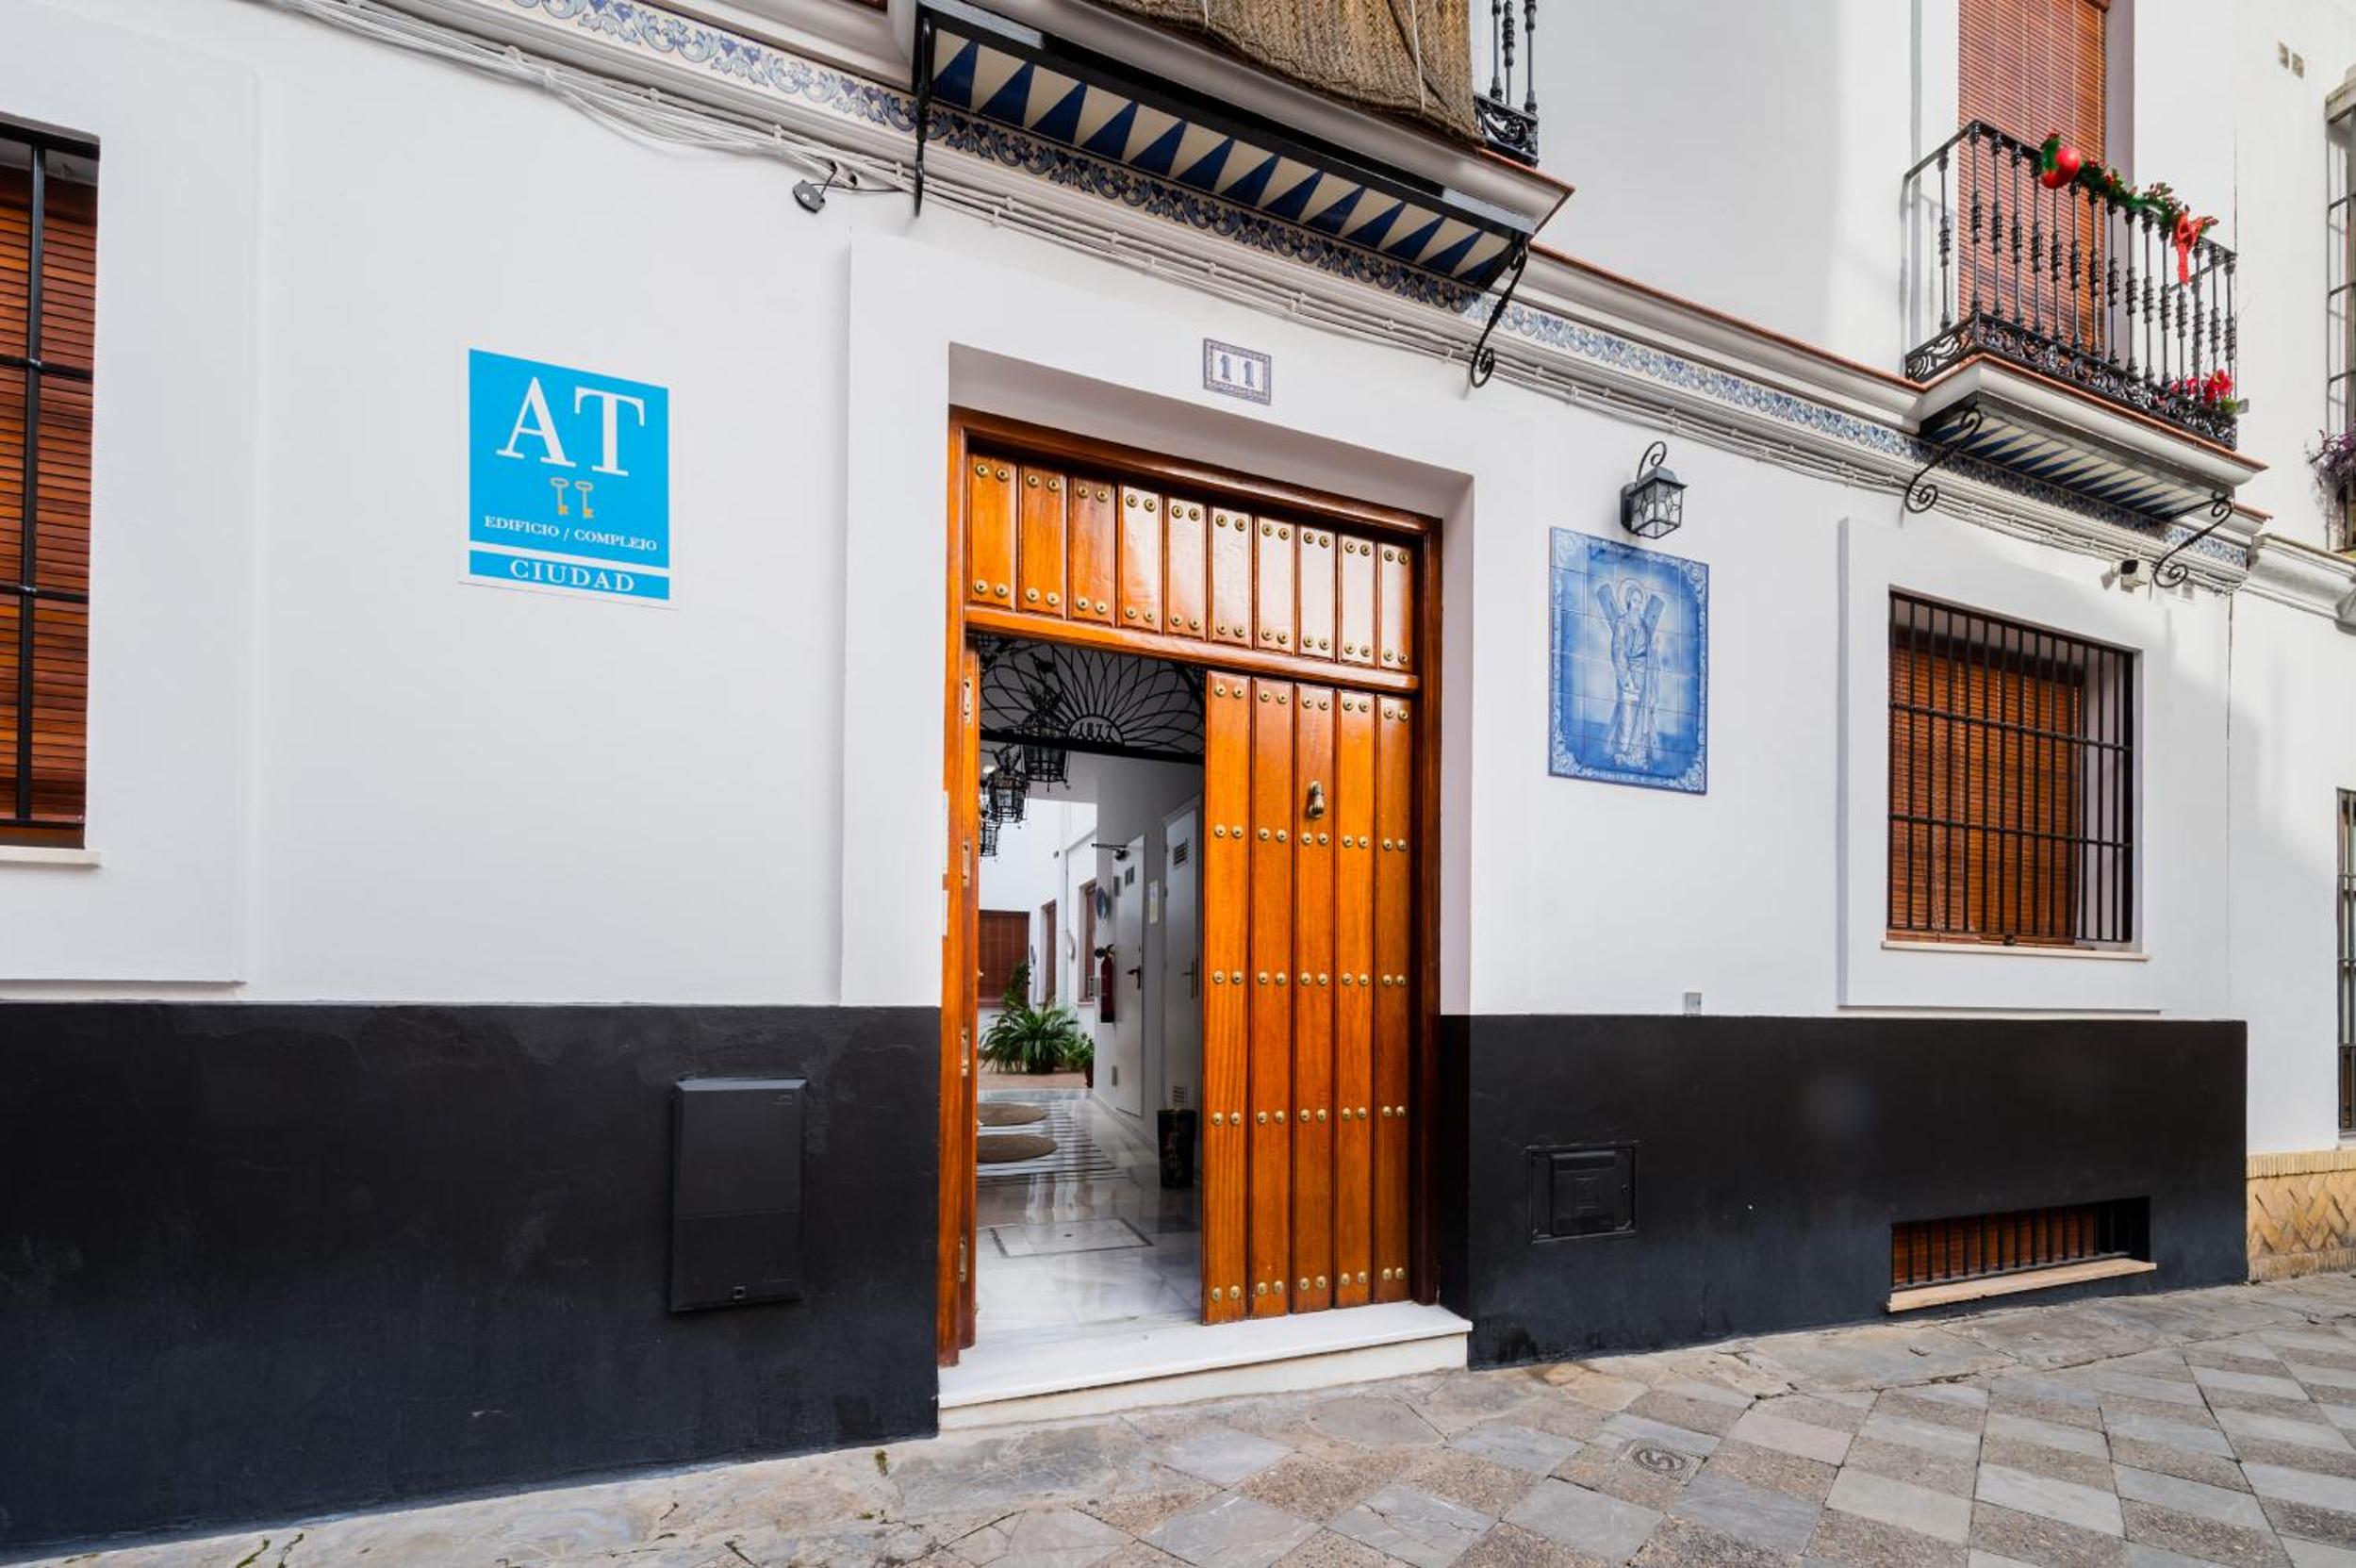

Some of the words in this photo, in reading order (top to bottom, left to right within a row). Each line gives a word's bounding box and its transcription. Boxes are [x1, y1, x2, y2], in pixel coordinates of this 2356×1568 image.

[1220, 354, 1255, 388] 11
[496, 376, 645, 476] AT
[484, 515, 560, 537] EDIFICIO
[573, 528, 658, 552] COMPLEJO
[509, 559, 635, 592] CIUDAD
